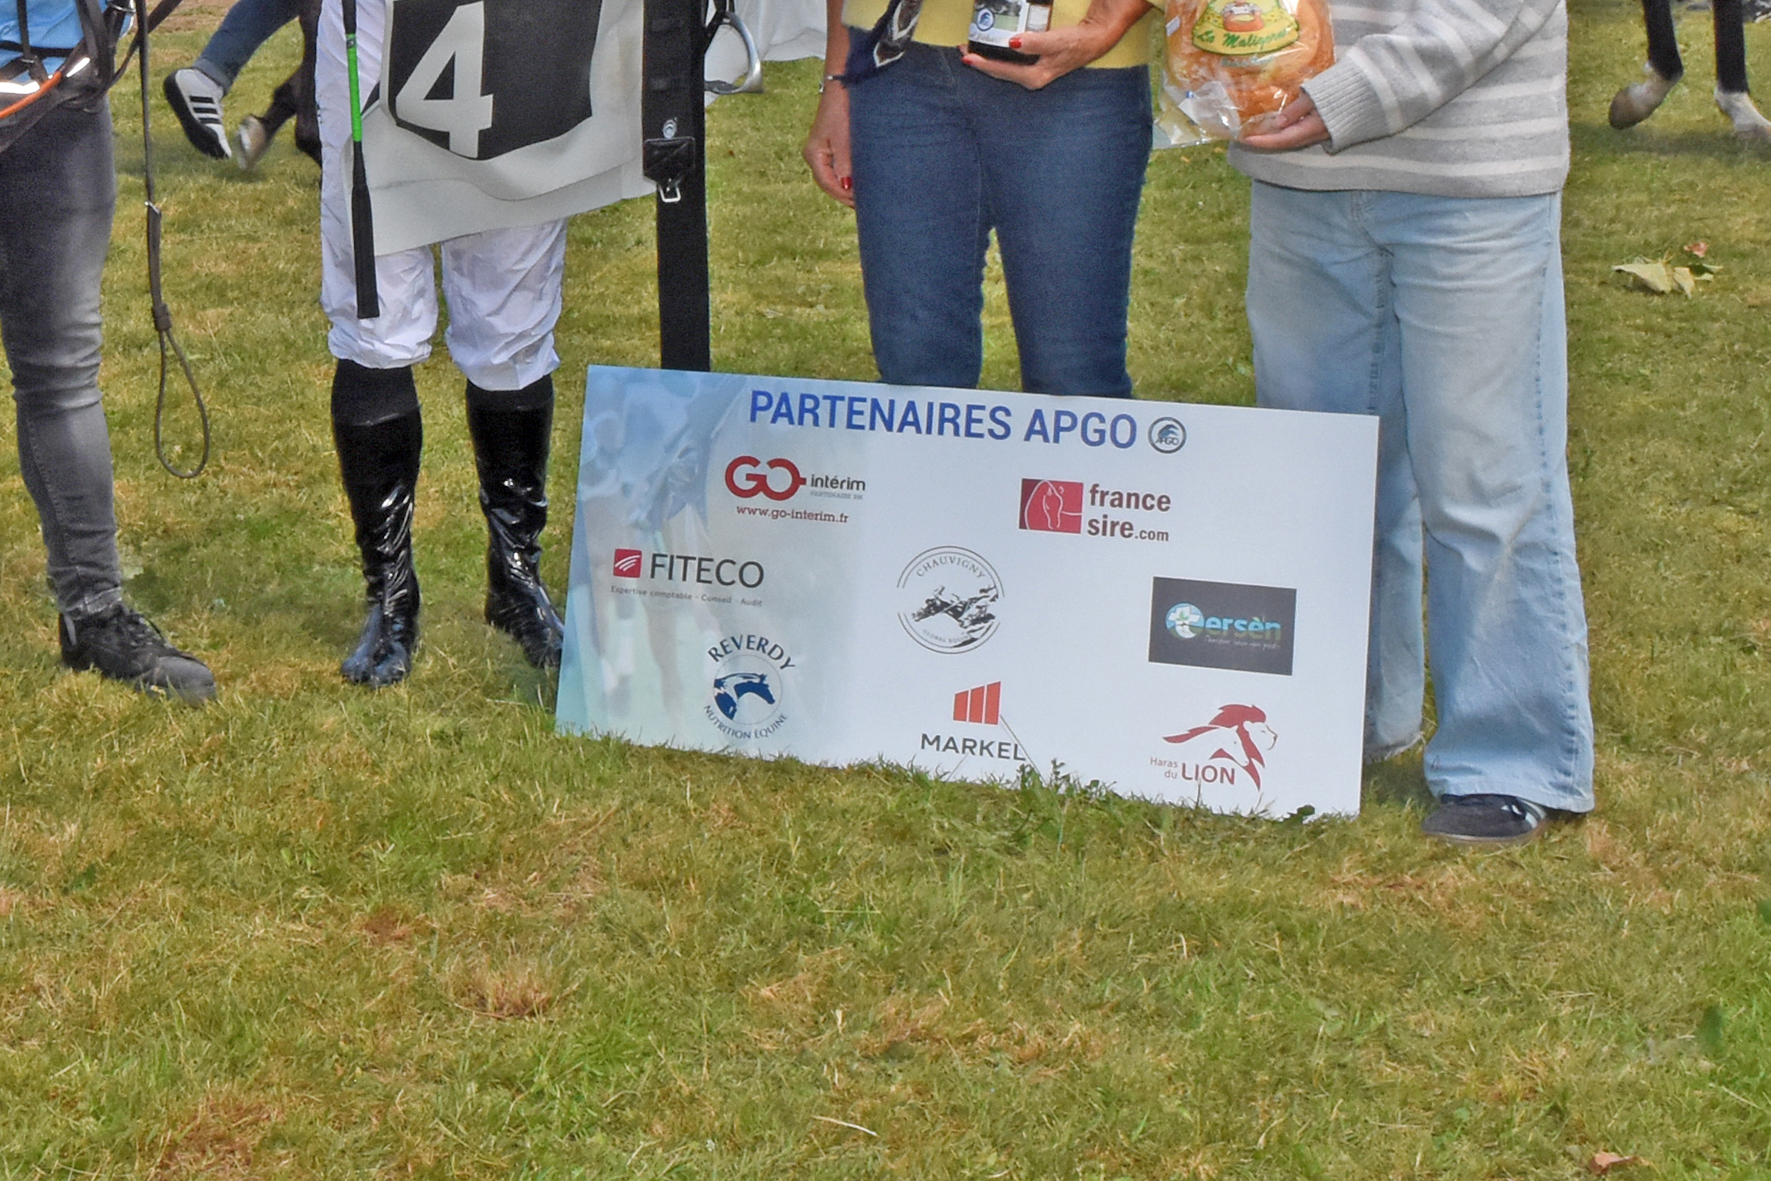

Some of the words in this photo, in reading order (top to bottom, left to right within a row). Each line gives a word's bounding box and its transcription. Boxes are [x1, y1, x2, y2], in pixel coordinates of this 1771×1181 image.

[395, 1, 493, 158] 4
[749, 390, 1012, 440] PARTENAIRES
[1023, 408, 1137, 449] APGO
[725, 455, 807, 501] GO
[810, 474, 866, 491] intérim
[1089, 483, 1171, 512] france
[736, 505, 849, 523] www.go-interim.fr
[1087, 514, 1170, 541] sire.com
[650, 553, 765, 588] FITECO
[916, 556, 986, 579] CHAUVIGNY
[610, 585, 648, 597] Expertise
[650, 589, 693, 601] comptable
[701, 594, 732, 604] Conseil
[740, 598, 763, 607] Audit
[708, 634, 795, 671] REVERDY
[704, 705, 752, 739] NUTRITION
[920, 733, 1027, 762] MARKEL
[1150, 757, 1179, 769] Haras
[1164, 770, 1178, 779] du
[1181, 763, 1236, 786] LION
